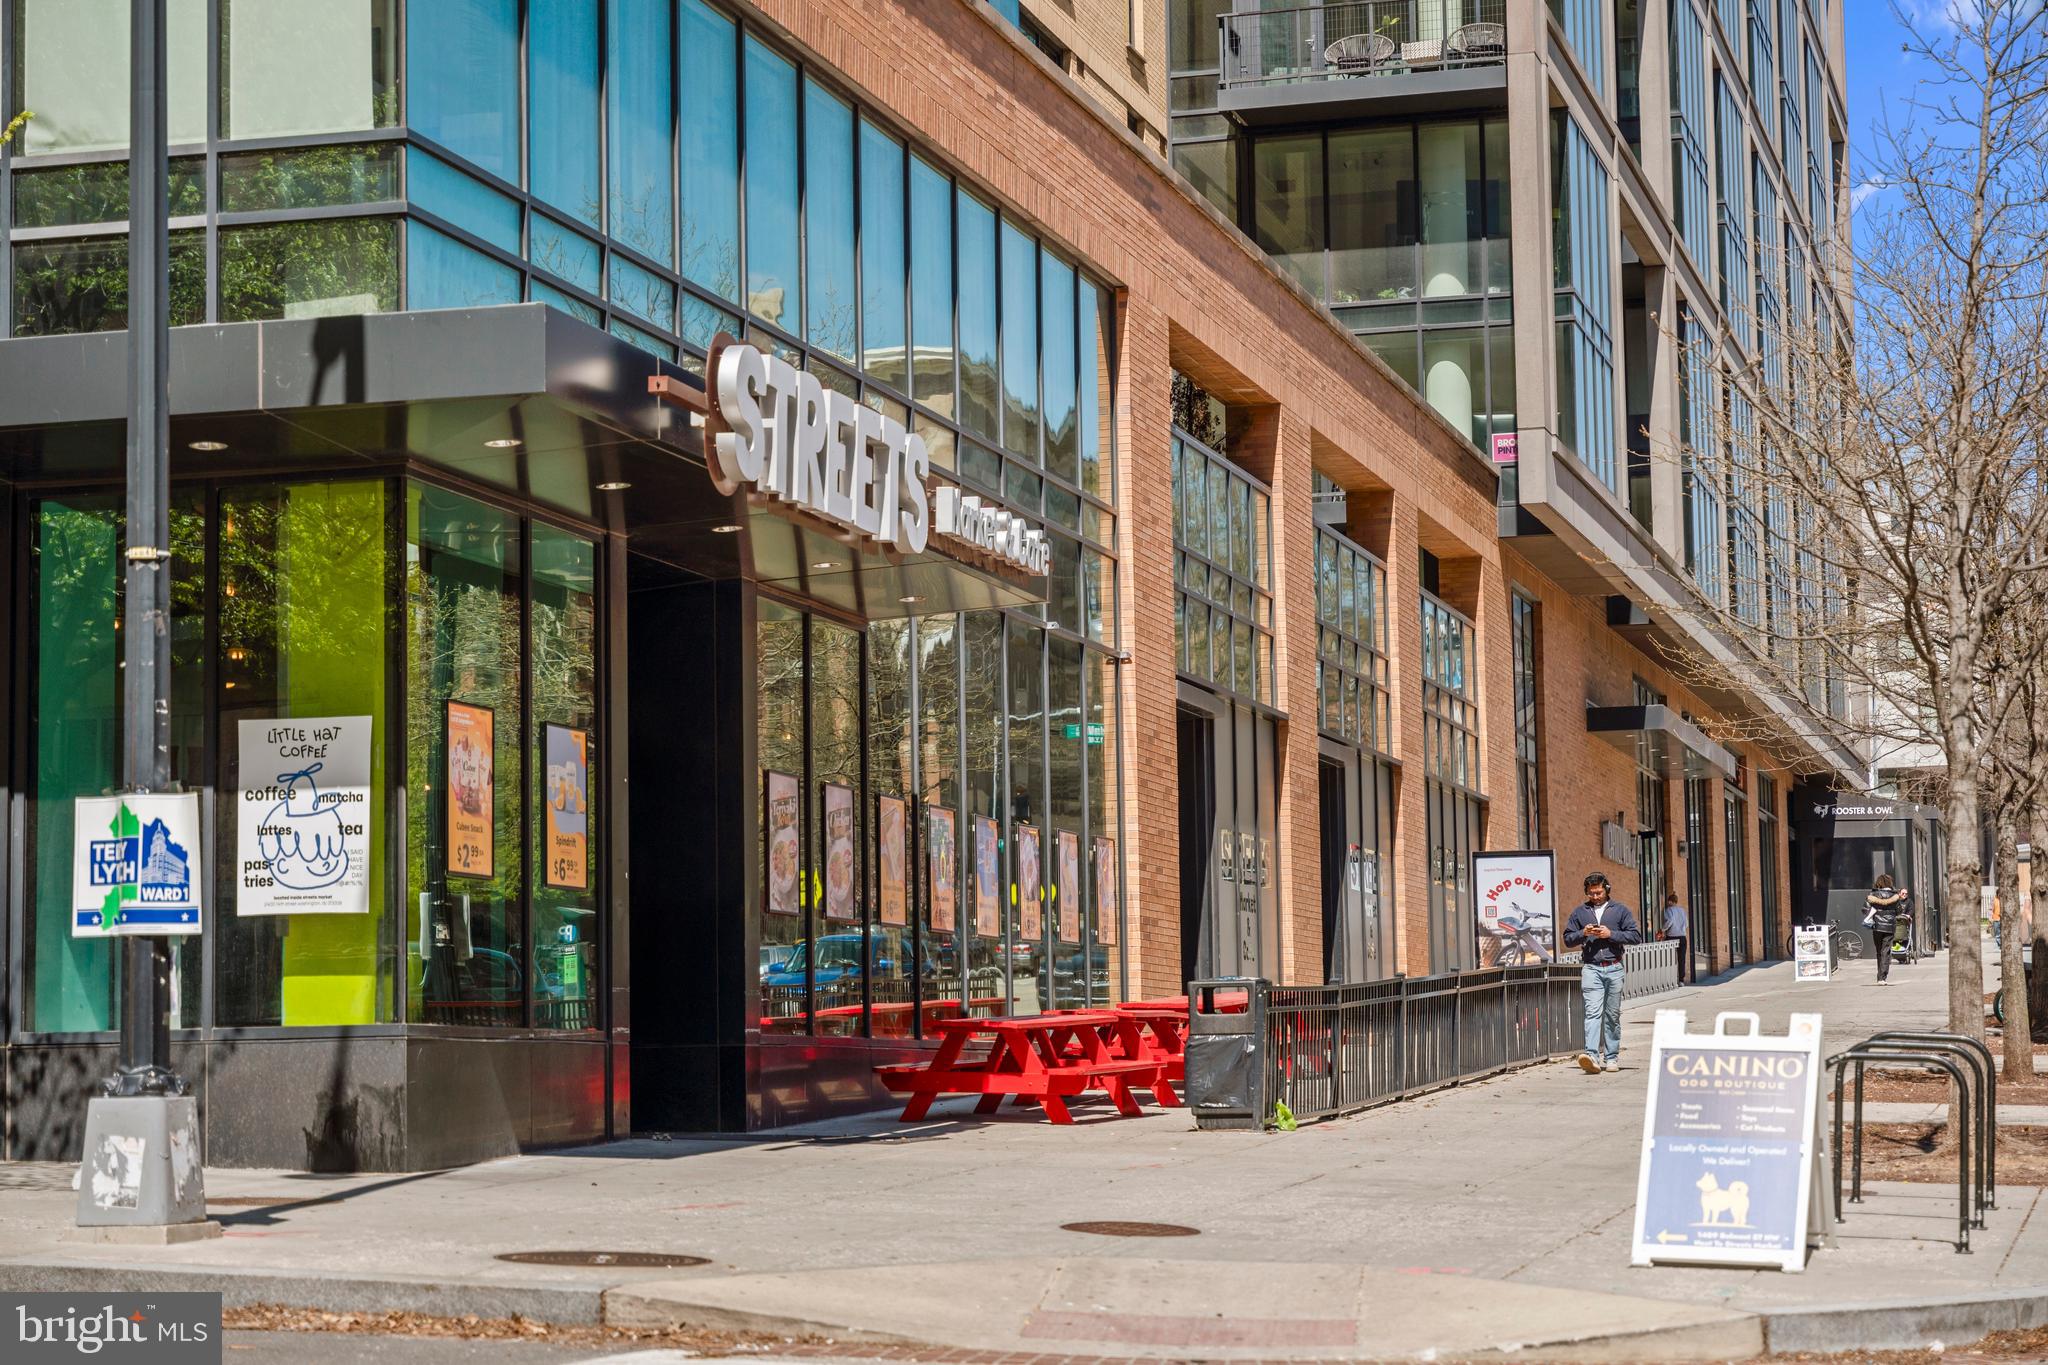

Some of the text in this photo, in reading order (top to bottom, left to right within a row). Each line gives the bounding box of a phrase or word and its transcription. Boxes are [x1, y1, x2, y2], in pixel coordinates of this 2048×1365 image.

[716, 344, 929, 553] STREETS
[267, 728, 306, 744] LITTLE
[280, 744, 327, 758] COFFEE
[245, 786, 297, 801] coffee
[318, 792, 364, 803] matcha
[1831, 806, 1893, 815] ROOSTER & OWL
[257, 825, 292, 836] lattes
[338, 824, 363, 836] tea
[244, 875, 274, 888] tries
[142, 887, 189, 900] WARD 1
[1486, 877, 1545, 901] Hop on it
[1666, 1054, 1804, 1079] CANINO
[1679, 1078, 1786, 1090] DOG BOUTIQUE
[1669, 1143, 1787, 1156] Locally Owned and Operated
[1703, 1156, 1717, 1165] We
